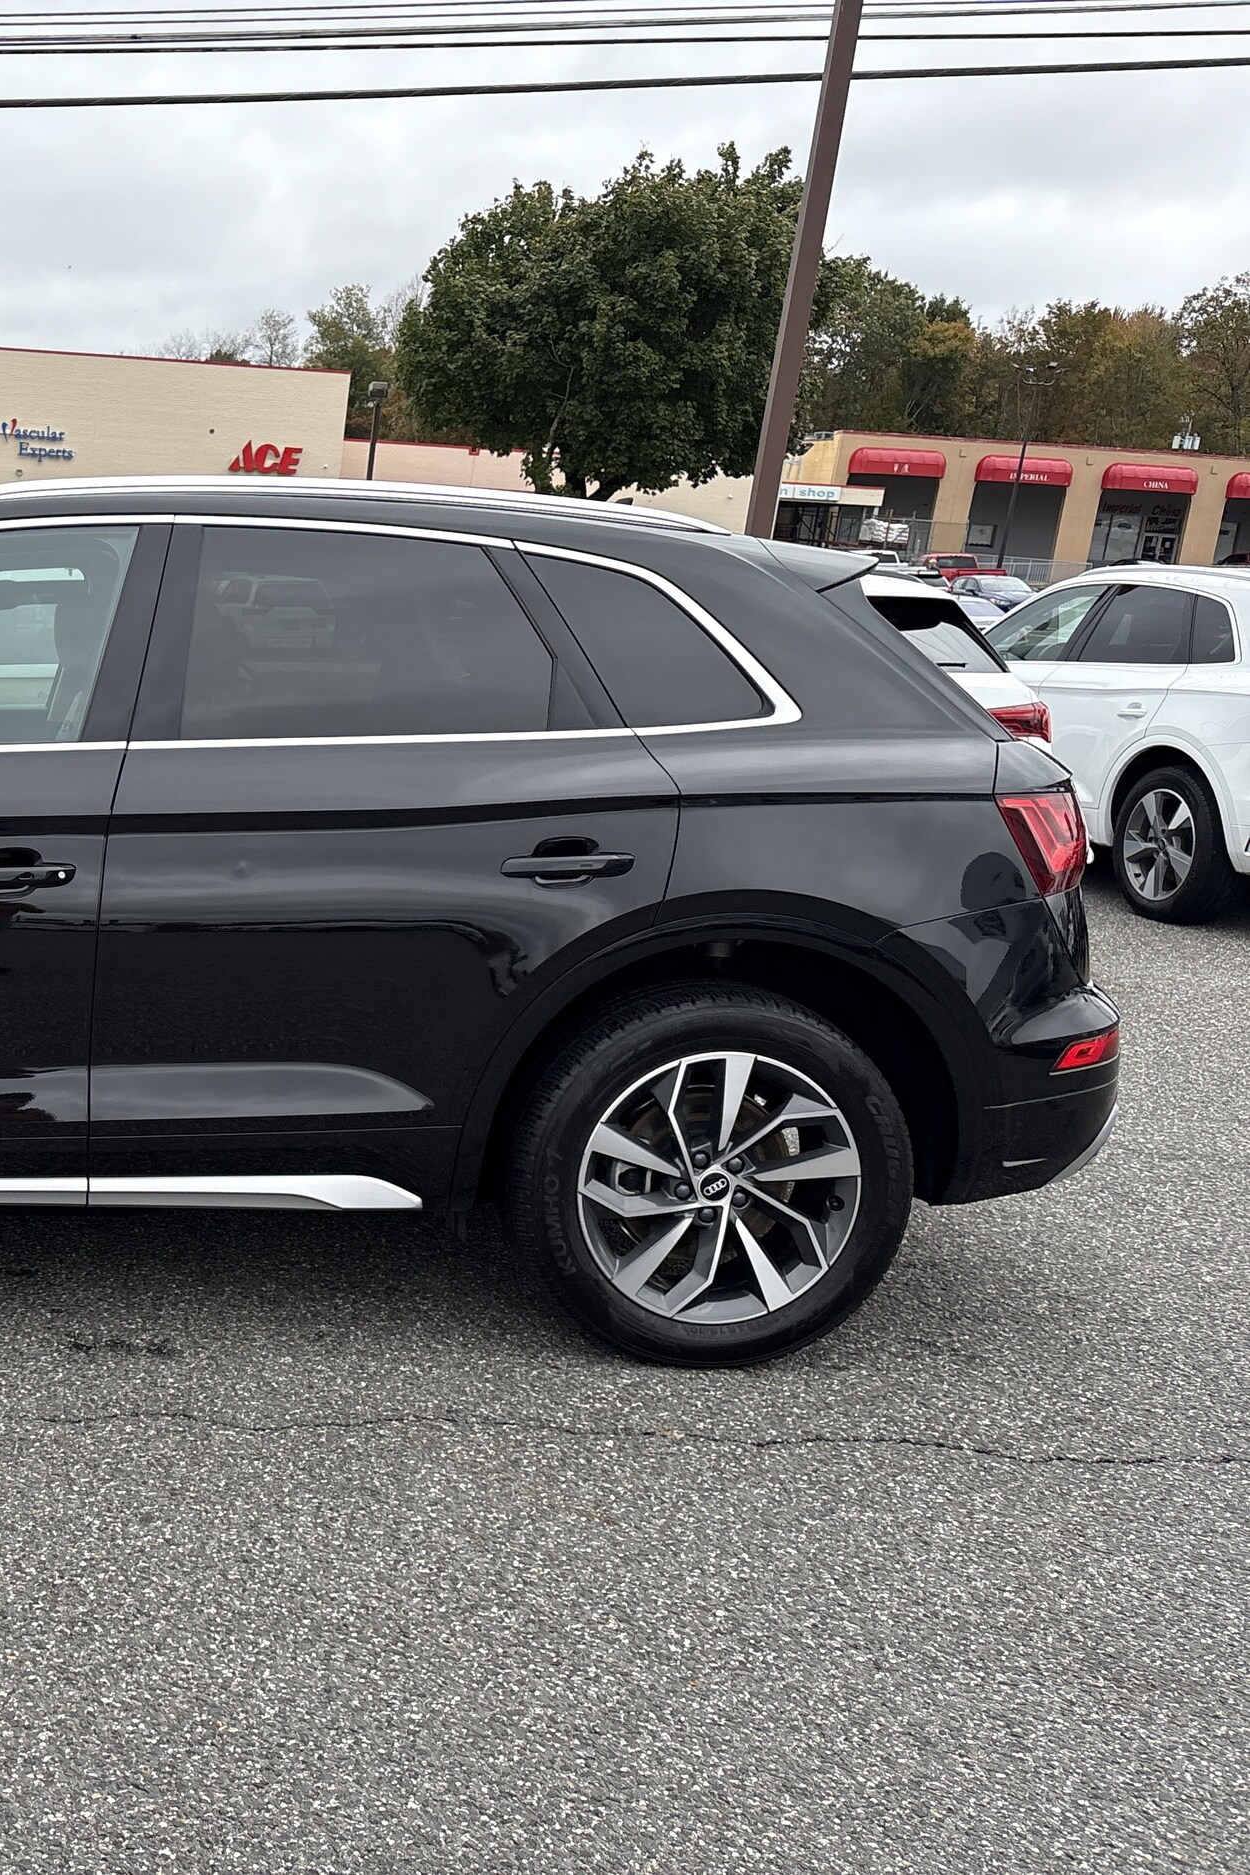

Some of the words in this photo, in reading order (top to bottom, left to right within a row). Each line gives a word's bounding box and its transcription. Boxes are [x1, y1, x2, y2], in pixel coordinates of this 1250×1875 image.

[1, 418, 65, 442] Vascular
[18, 441, 75, 462] Experts
[228, 439, 303, 475] ACE
[799, 487, 835, 500] shop
[1143, 481, 1168, 489] CHINA
[1102, 502, 1142, 515] Imperial
